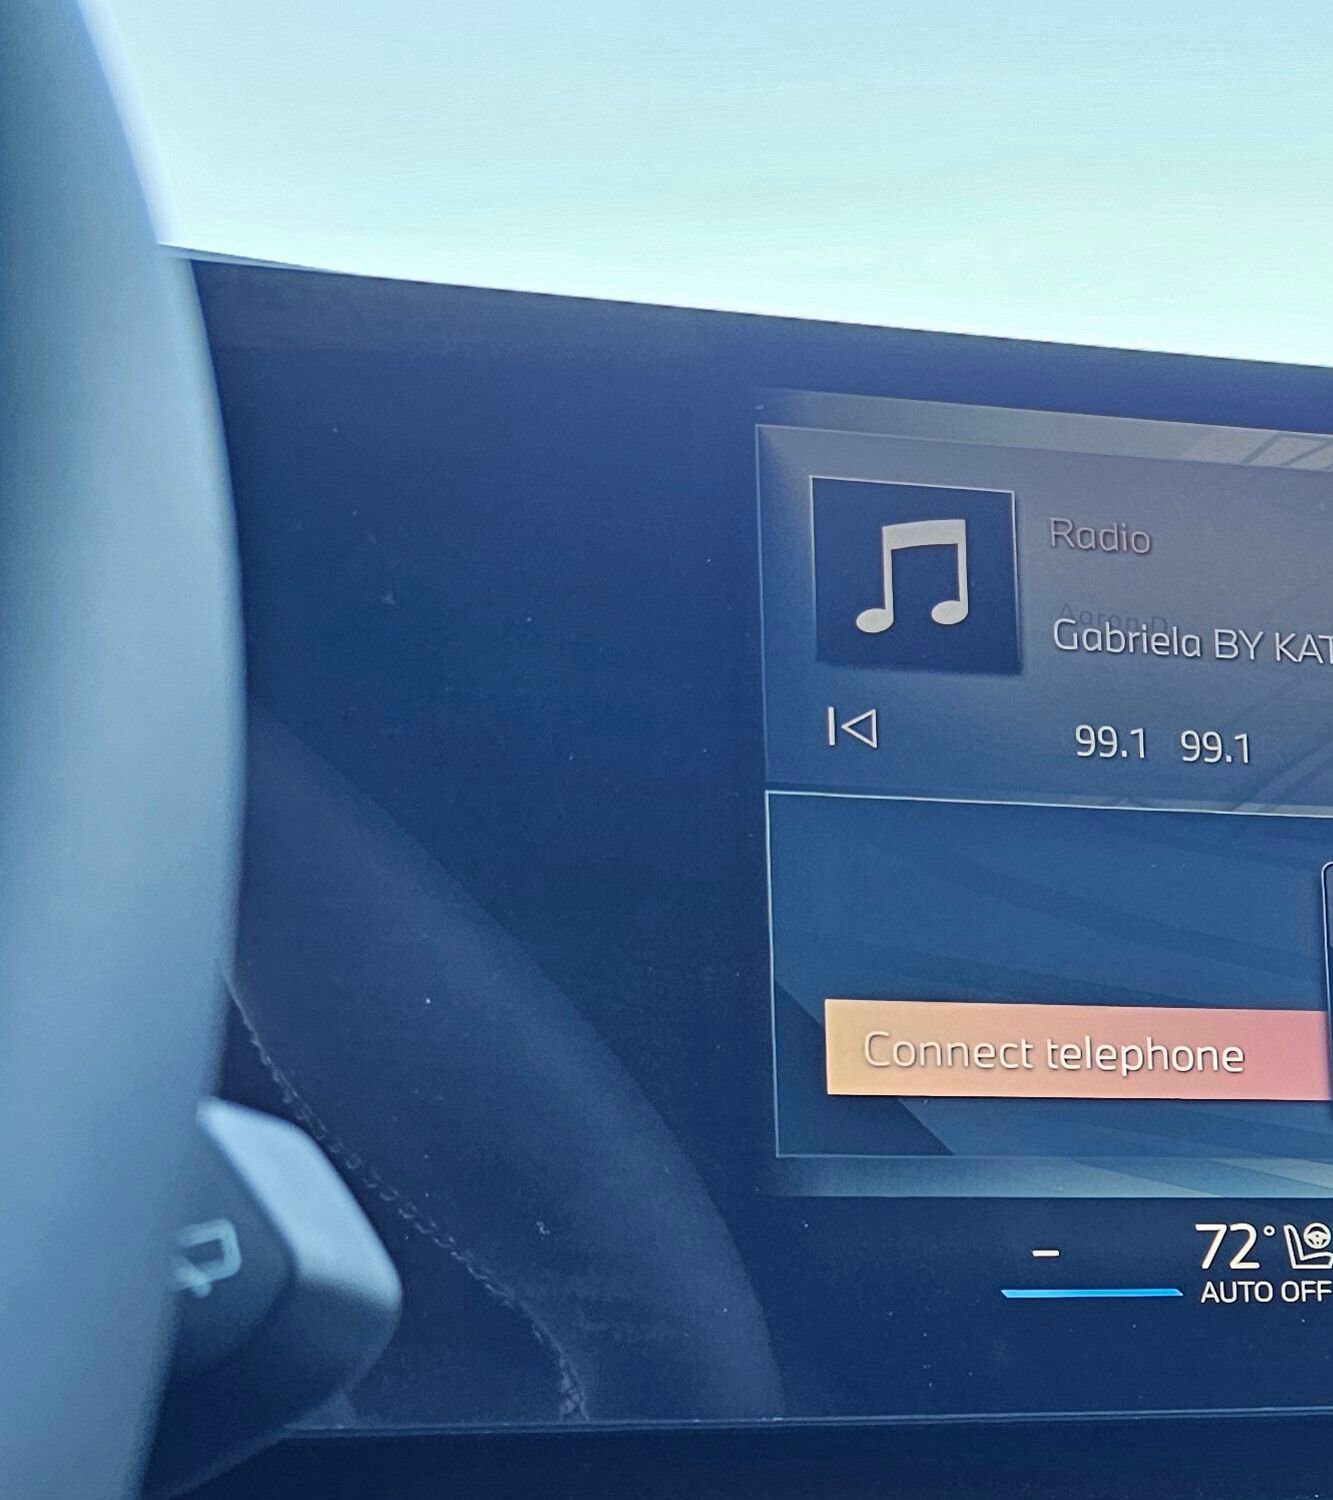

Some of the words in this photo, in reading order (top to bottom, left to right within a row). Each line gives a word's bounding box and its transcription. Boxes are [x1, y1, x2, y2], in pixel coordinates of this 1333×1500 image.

[1049, 517, 1152, 555] Radio
[1053, 617, 1201, 658] Gabriela
[1213, 627, 1264, 661] BY
[1074, 724, 1146, 759] 99.1
[1180, 729, 1250, 764] 99.1
[862, 1030, 1034, 1071] Connect
[1046, 1035, 1246, 1078] telephone
[1194, 1221, 1275, 1271] 72°
[1200, 1280, 1274, 1304] AUTO
[1280, 1280, 1333, 1303] OFF
